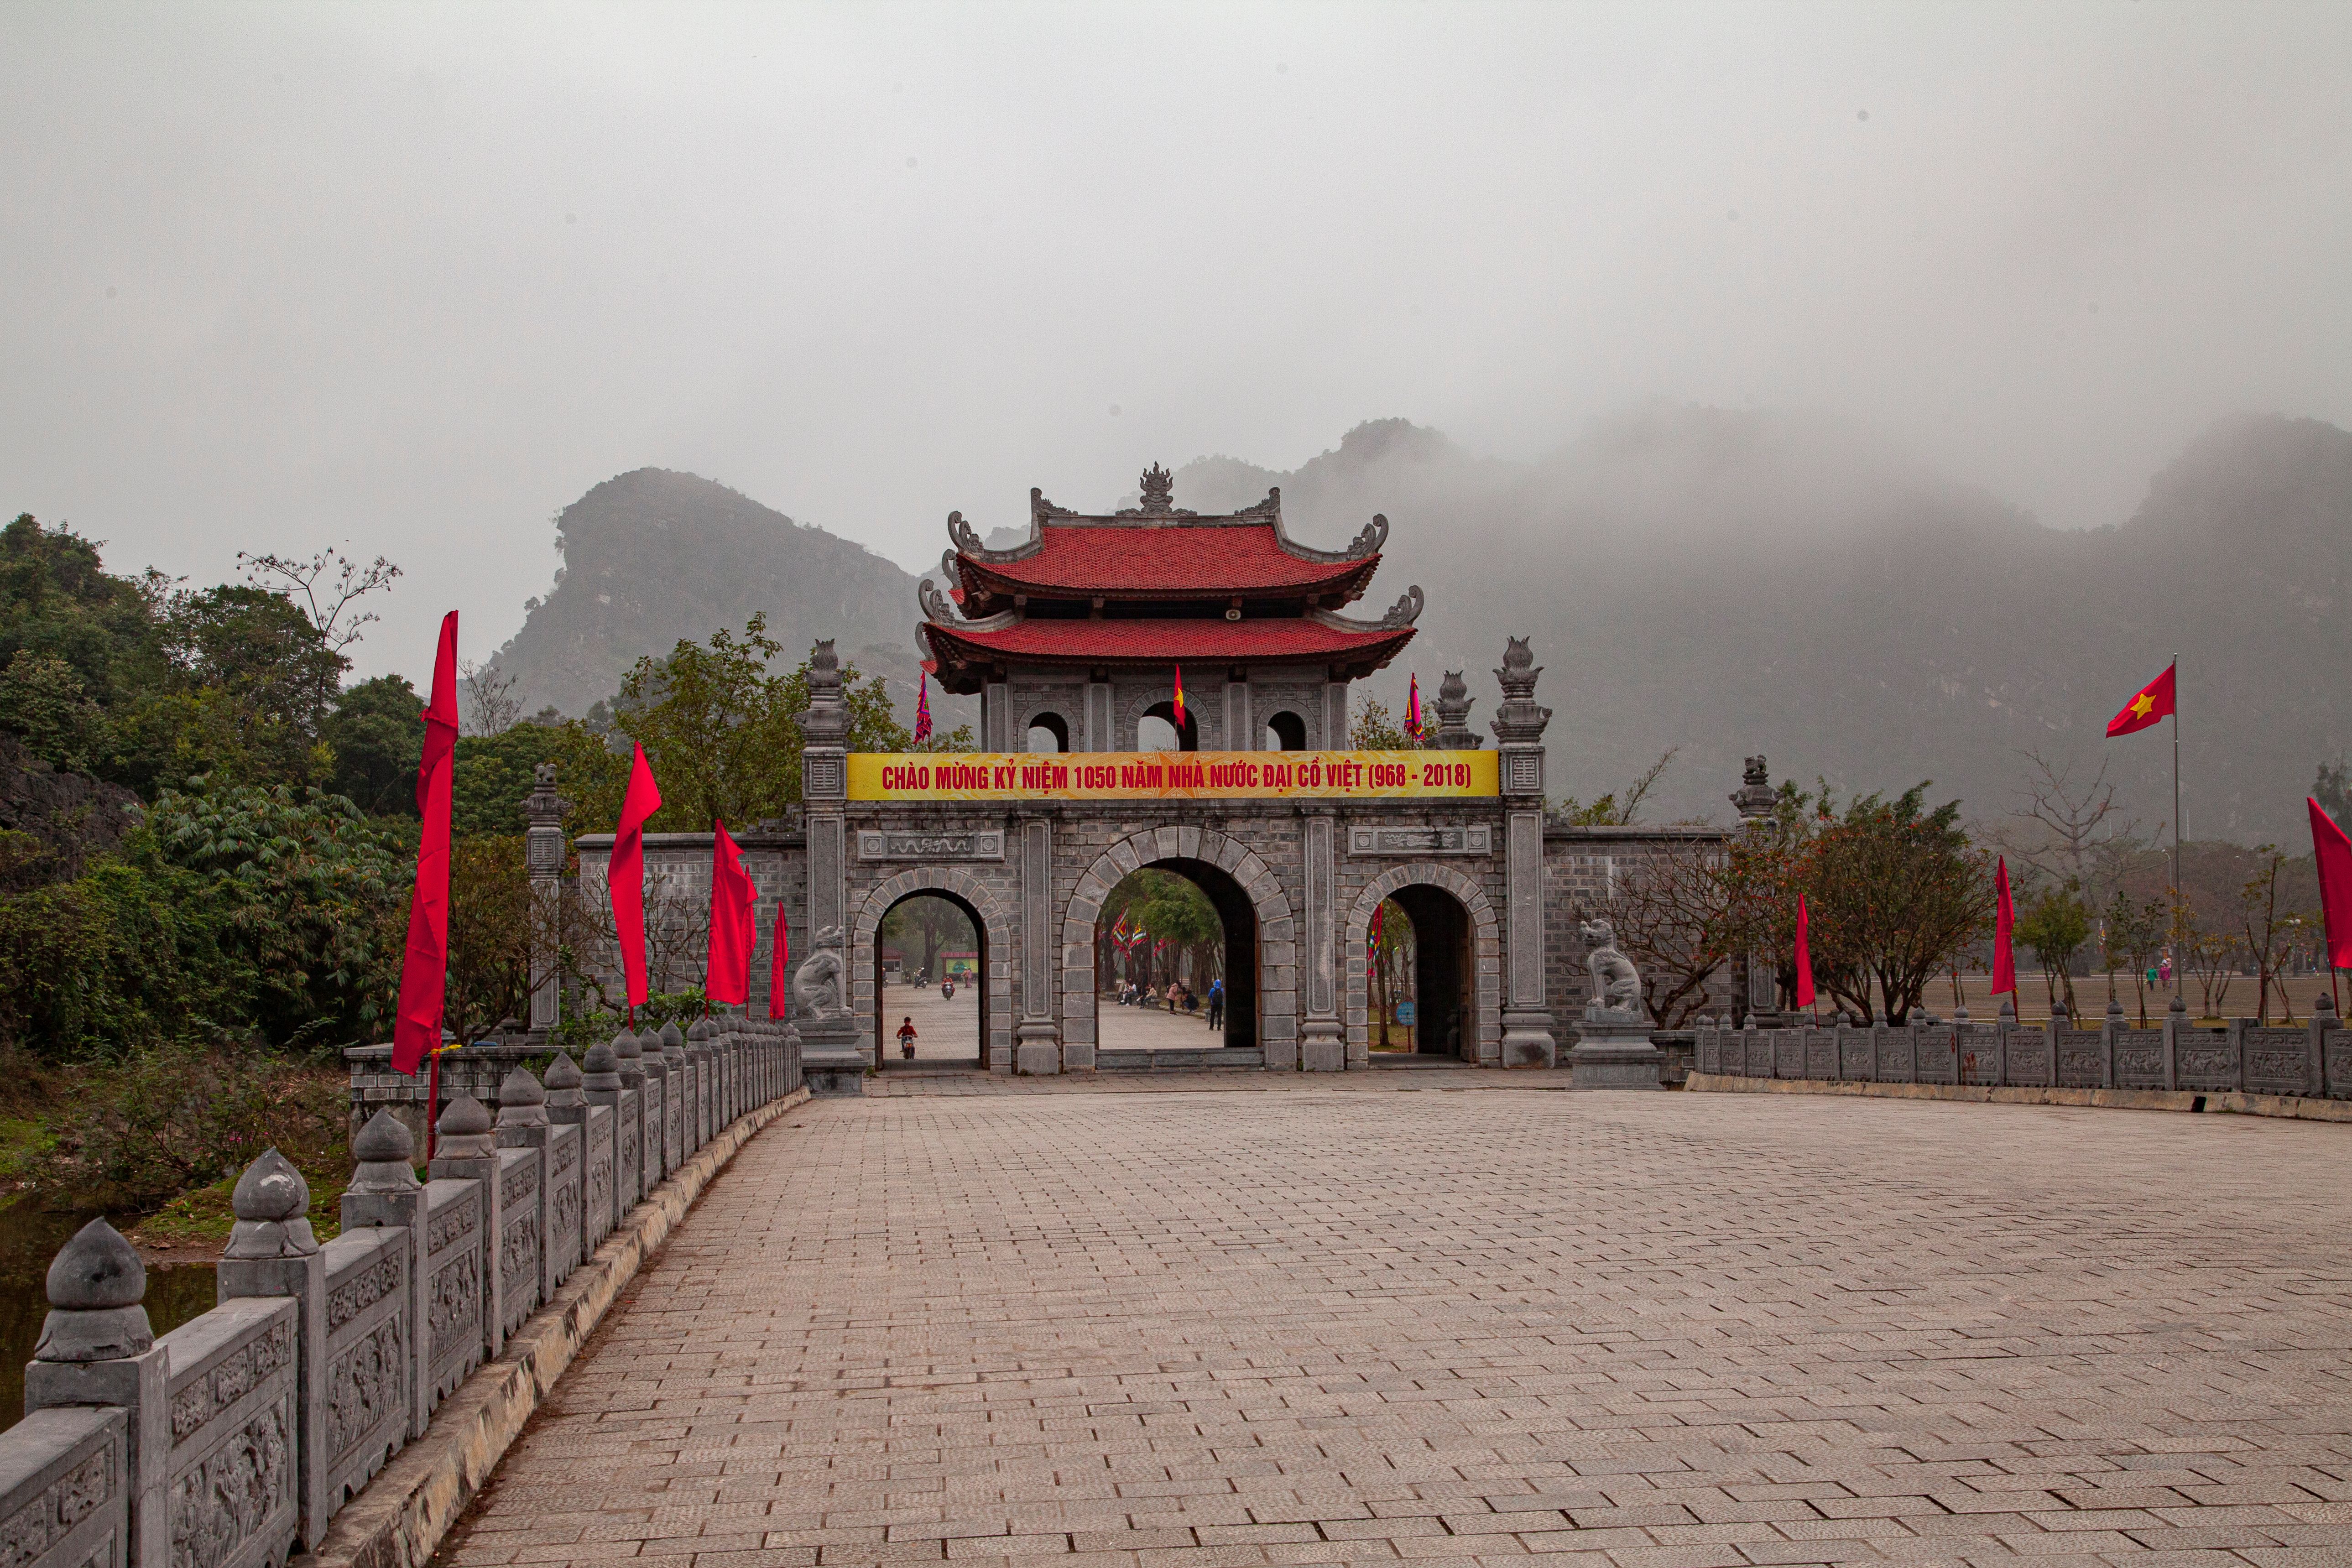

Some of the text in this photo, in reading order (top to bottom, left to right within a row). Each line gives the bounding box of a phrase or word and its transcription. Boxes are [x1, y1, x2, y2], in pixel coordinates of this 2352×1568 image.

[882, 762, 929, 789] CHÀO
[936, 761, 988, 789] MỪNG
[994, 758, 1017, 789] KỶ
[1022, 761, 1068, 794] NIỆM
[1074, 766, 1116, 789] 1050
[1121, 761, 1162, 788] NĂM
[1168, 761, 1205, 787] NHÀ
[1210, 760, 1257, 787] NƯỚC
[1263, 764, 1292, 792] ĐẠI
[1298, 756, 1321, 787] CỒ
[1326, 759, 1362, 792] VIỆT
[1369, 764, 1406, 789] (968
[1423, 764, 1471, 789] 2018)
